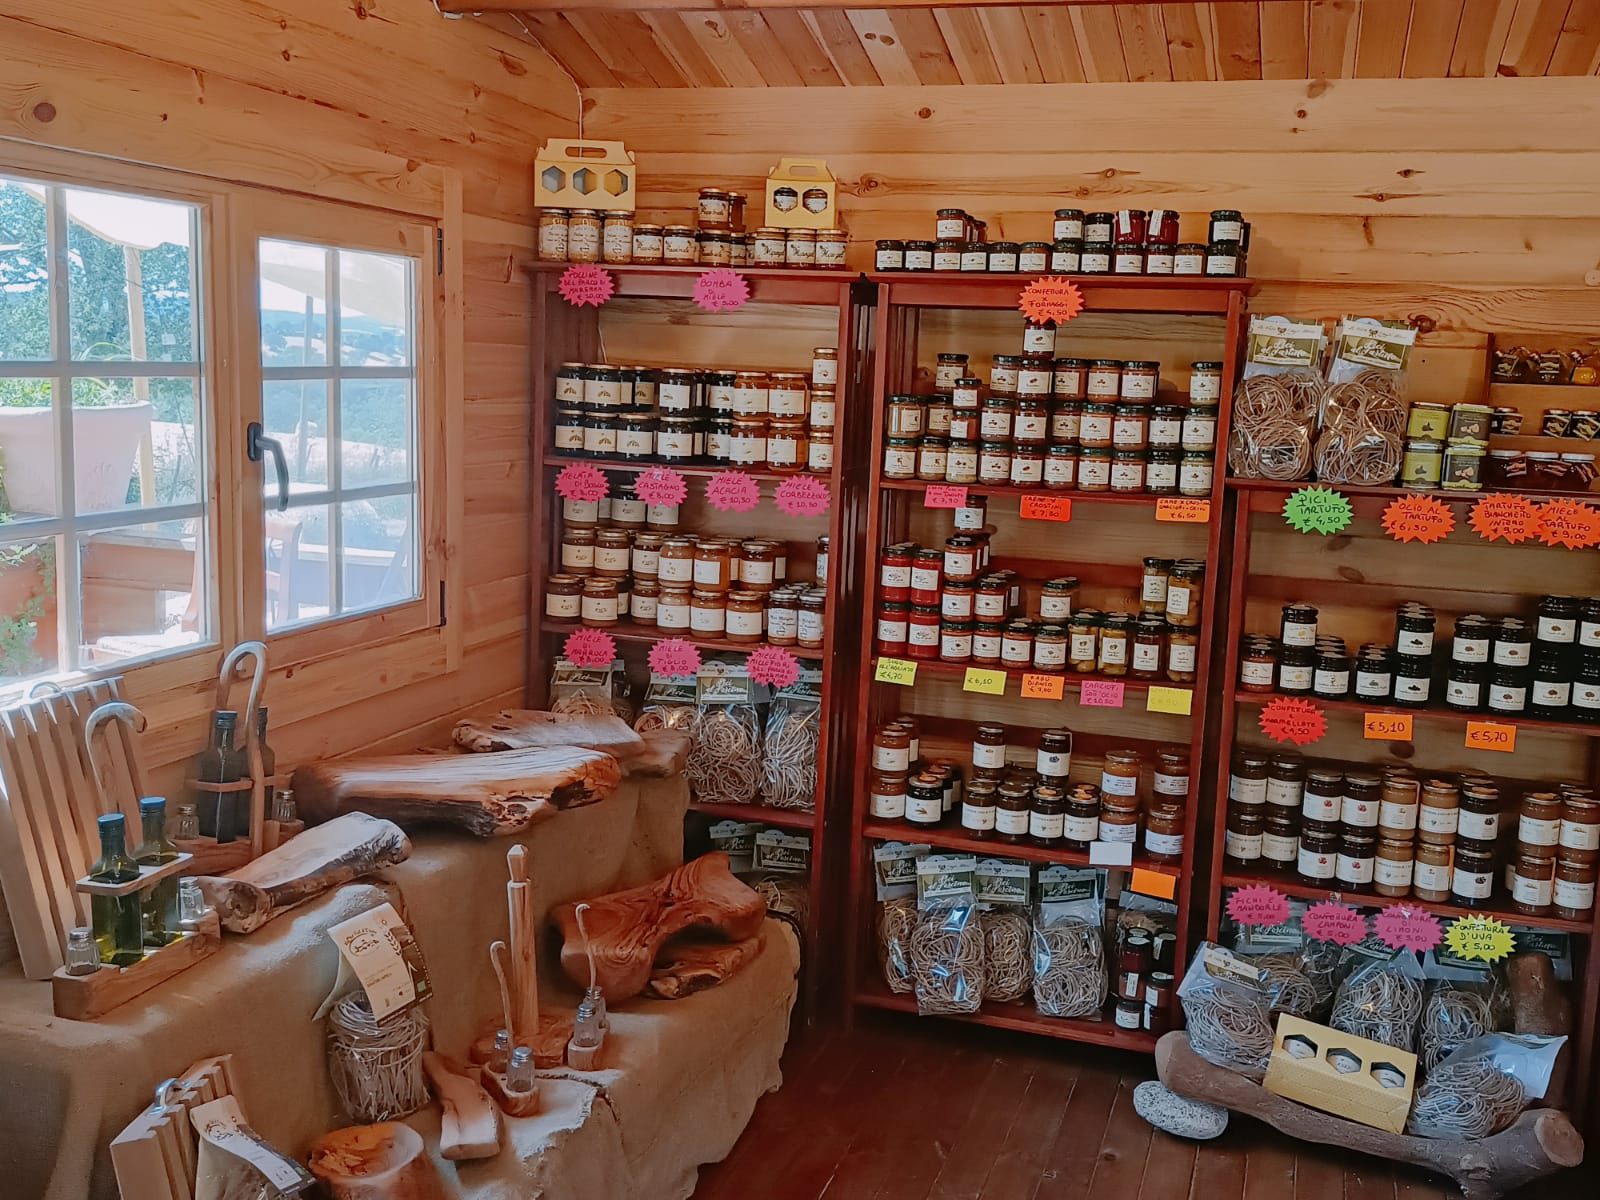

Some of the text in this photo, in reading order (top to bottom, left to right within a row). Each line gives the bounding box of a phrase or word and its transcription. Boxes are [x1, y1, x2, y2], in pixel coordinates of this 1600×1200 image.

[700, 279, 732, 288] BOMBA
[562, 472, 593, 480] MELATA
[638, 482, 680, 491] CASTAGNO
[711, 486, 747, 495] ACACIA
[785, 482, 812, 491] MIELE
[1299, 494, 1327, 506] PICI
[1296, 504, 1346, 514] TARTUFO
[1399, 503, 1422, 511] OLIO
[1547, 507, 1578, 515] MIELE
[1303, 516, 1340, 526] € 4,50
[1402, 512, 1442, 523] TARTUFO
[1544, 520, 1591, 531] TARTUFO
[1366, 721, 1405, 733] € 5,10
[1471, 731, 1508, 742] € 5,70
[1460, 932, 1492, 940] D'UVA
